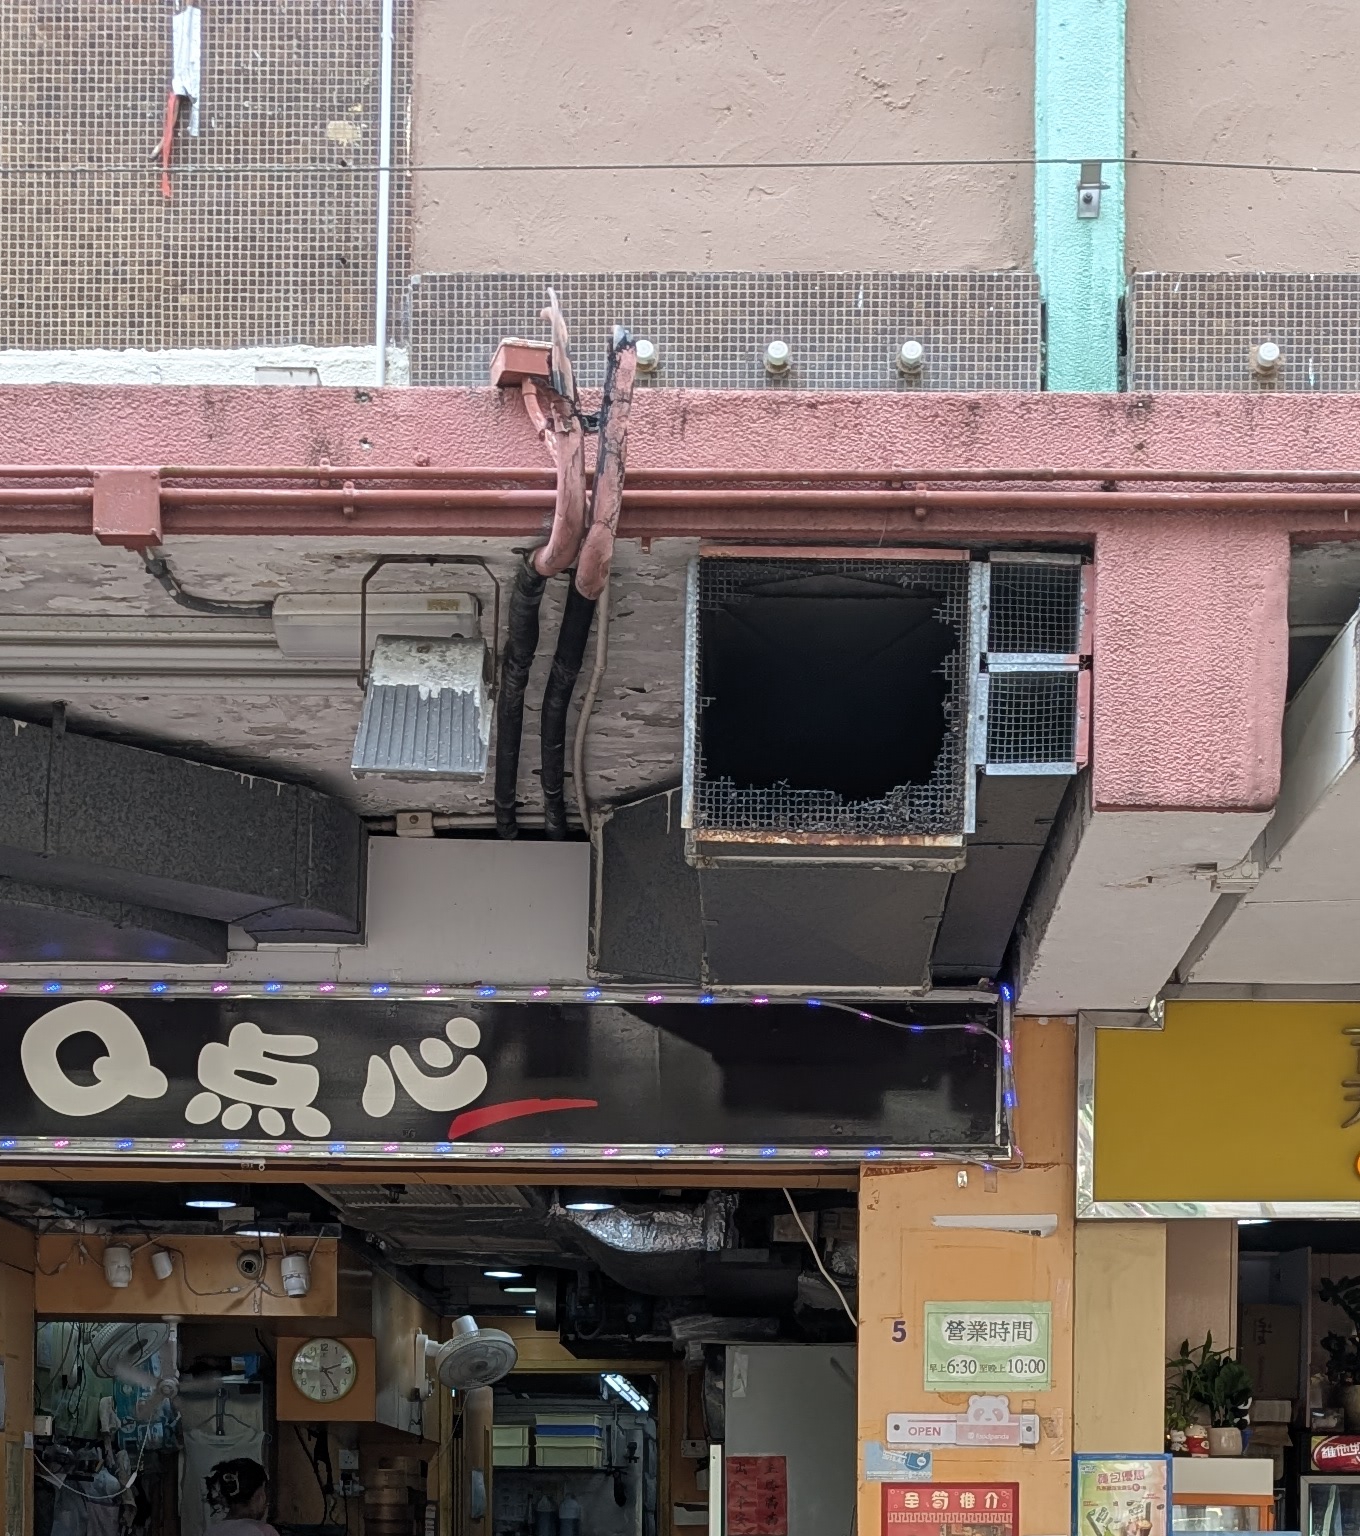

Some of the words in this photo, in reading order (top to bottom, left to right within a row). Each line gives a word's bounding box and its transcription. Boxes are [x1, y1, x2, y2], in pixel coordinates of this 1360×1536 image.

[891, 1320, 907, 1343] 5
[944, 1319, 1034, 1343] 營業時間
[908, 1426, 942, 1437] OPEN
[975, 1432, 1010, 1441] foodpanda
